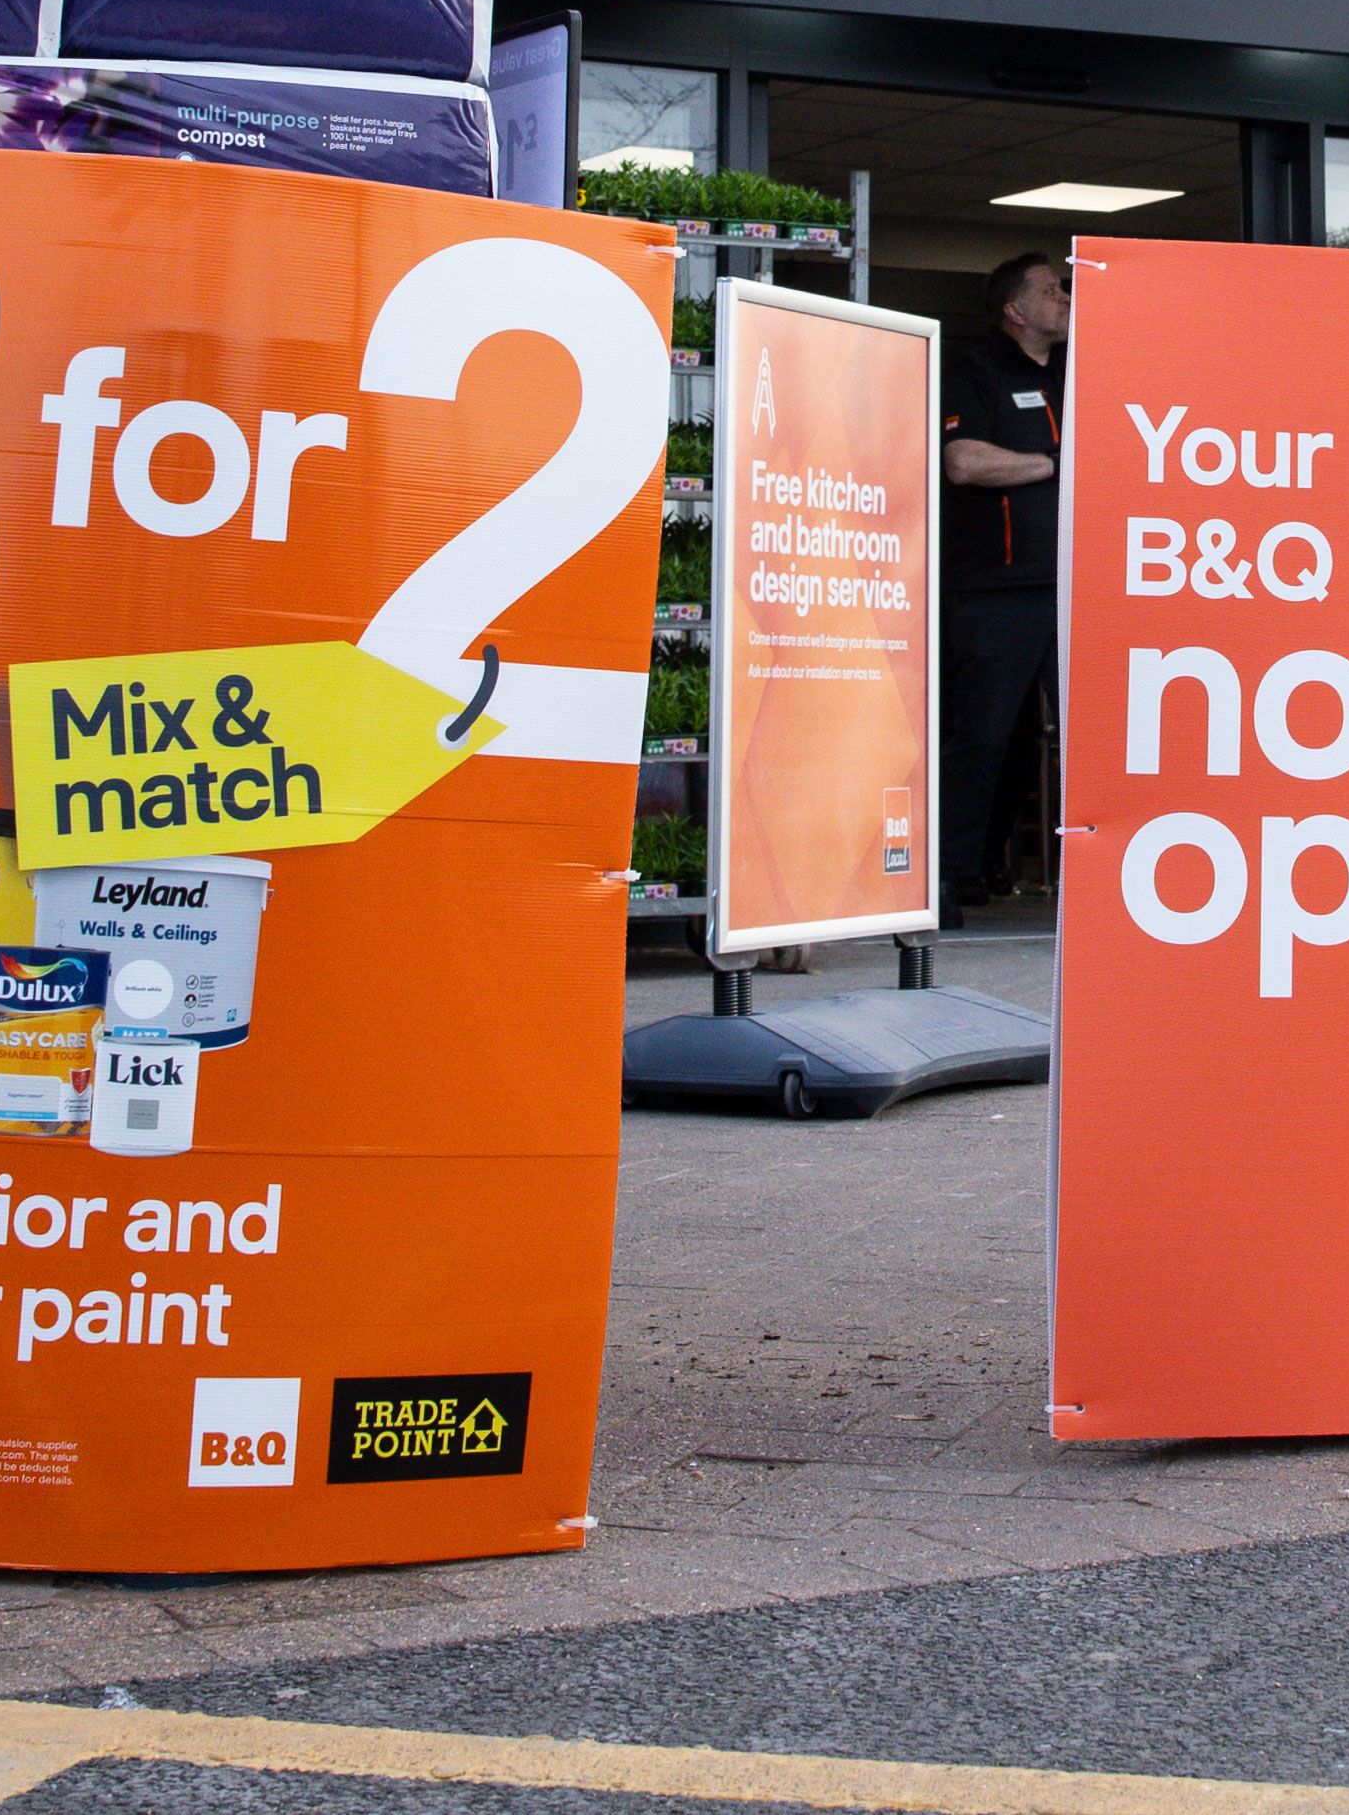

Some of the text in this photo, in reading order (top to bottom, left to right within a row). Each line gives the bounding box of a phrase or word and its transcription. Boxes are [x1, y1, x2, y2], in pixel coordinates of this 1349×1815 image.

[177, 104, 320, 132] multi-purpose
[177, 127, 266, 150] compost
[1125, 404, 1333, 488] Your
[41, 346, 348, 541] for
[356, 237, 670, 766] 2
[752, 459, 886, 515] Free kitchen
[751, 513, 900, 563] and bathroom
[1126, 517, 1332, 602] B&Q
[750, 560, 910, 617] design service.
[52, 674, 273, 760] Mix &
[55, 746, 322, 836] match
[885, 817, 909, 838] B&Q
[92, 876, 208, 913] Leyland
[80, 920, 218, 946] Walls & Ceilings
[43, 1051, 52, 1061] &
[54, 1051, 87, 1062] TOUGH
[108, 1052, 185, 1087] Lick
[124, 1183, 281, 1254] and
[18, 1270, 232, 1361] paint
[355, 1398, 458, 1430] TRADE
[200, 1432, 287, 1467] B&Q
[351, 1428, 456, 1460] POINT
[21, 1473, 37, 1484] for
[38, 1475, 75, 1486] details.
